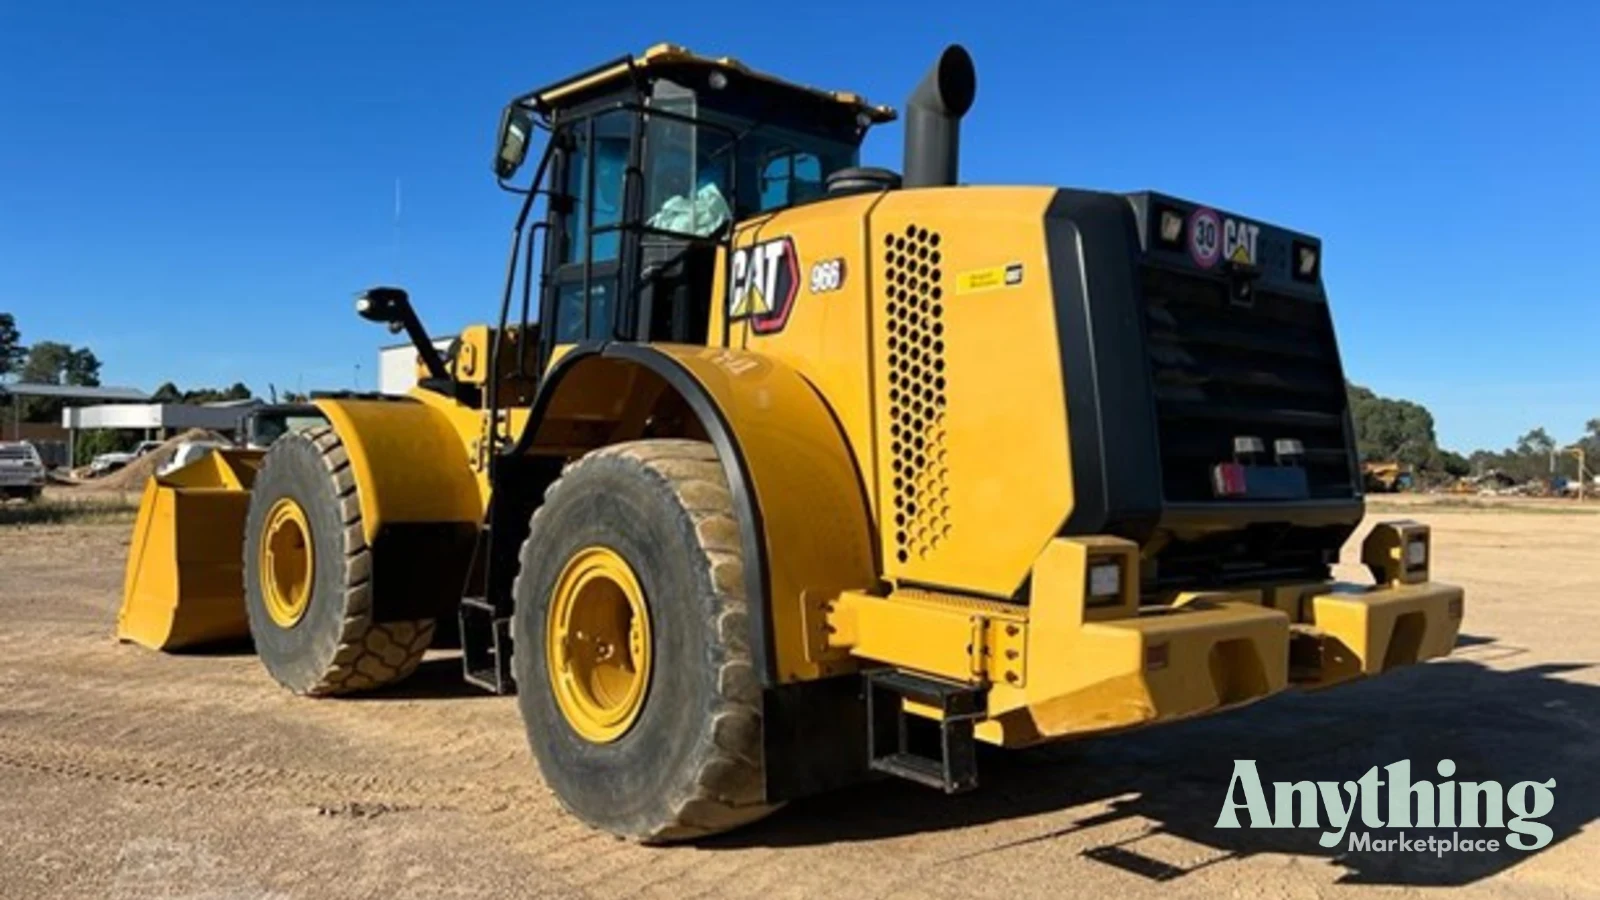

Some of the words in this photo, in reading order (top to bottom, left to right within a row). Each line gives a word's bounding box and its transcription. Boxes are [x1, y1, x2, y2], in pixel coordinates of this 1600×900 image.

[1195, 220, 1216, 247] 30
[1224, 219, 1260, 264] CAT
[730, 240, 784, 316] CAT
[809, 260, 841, 292] 966
